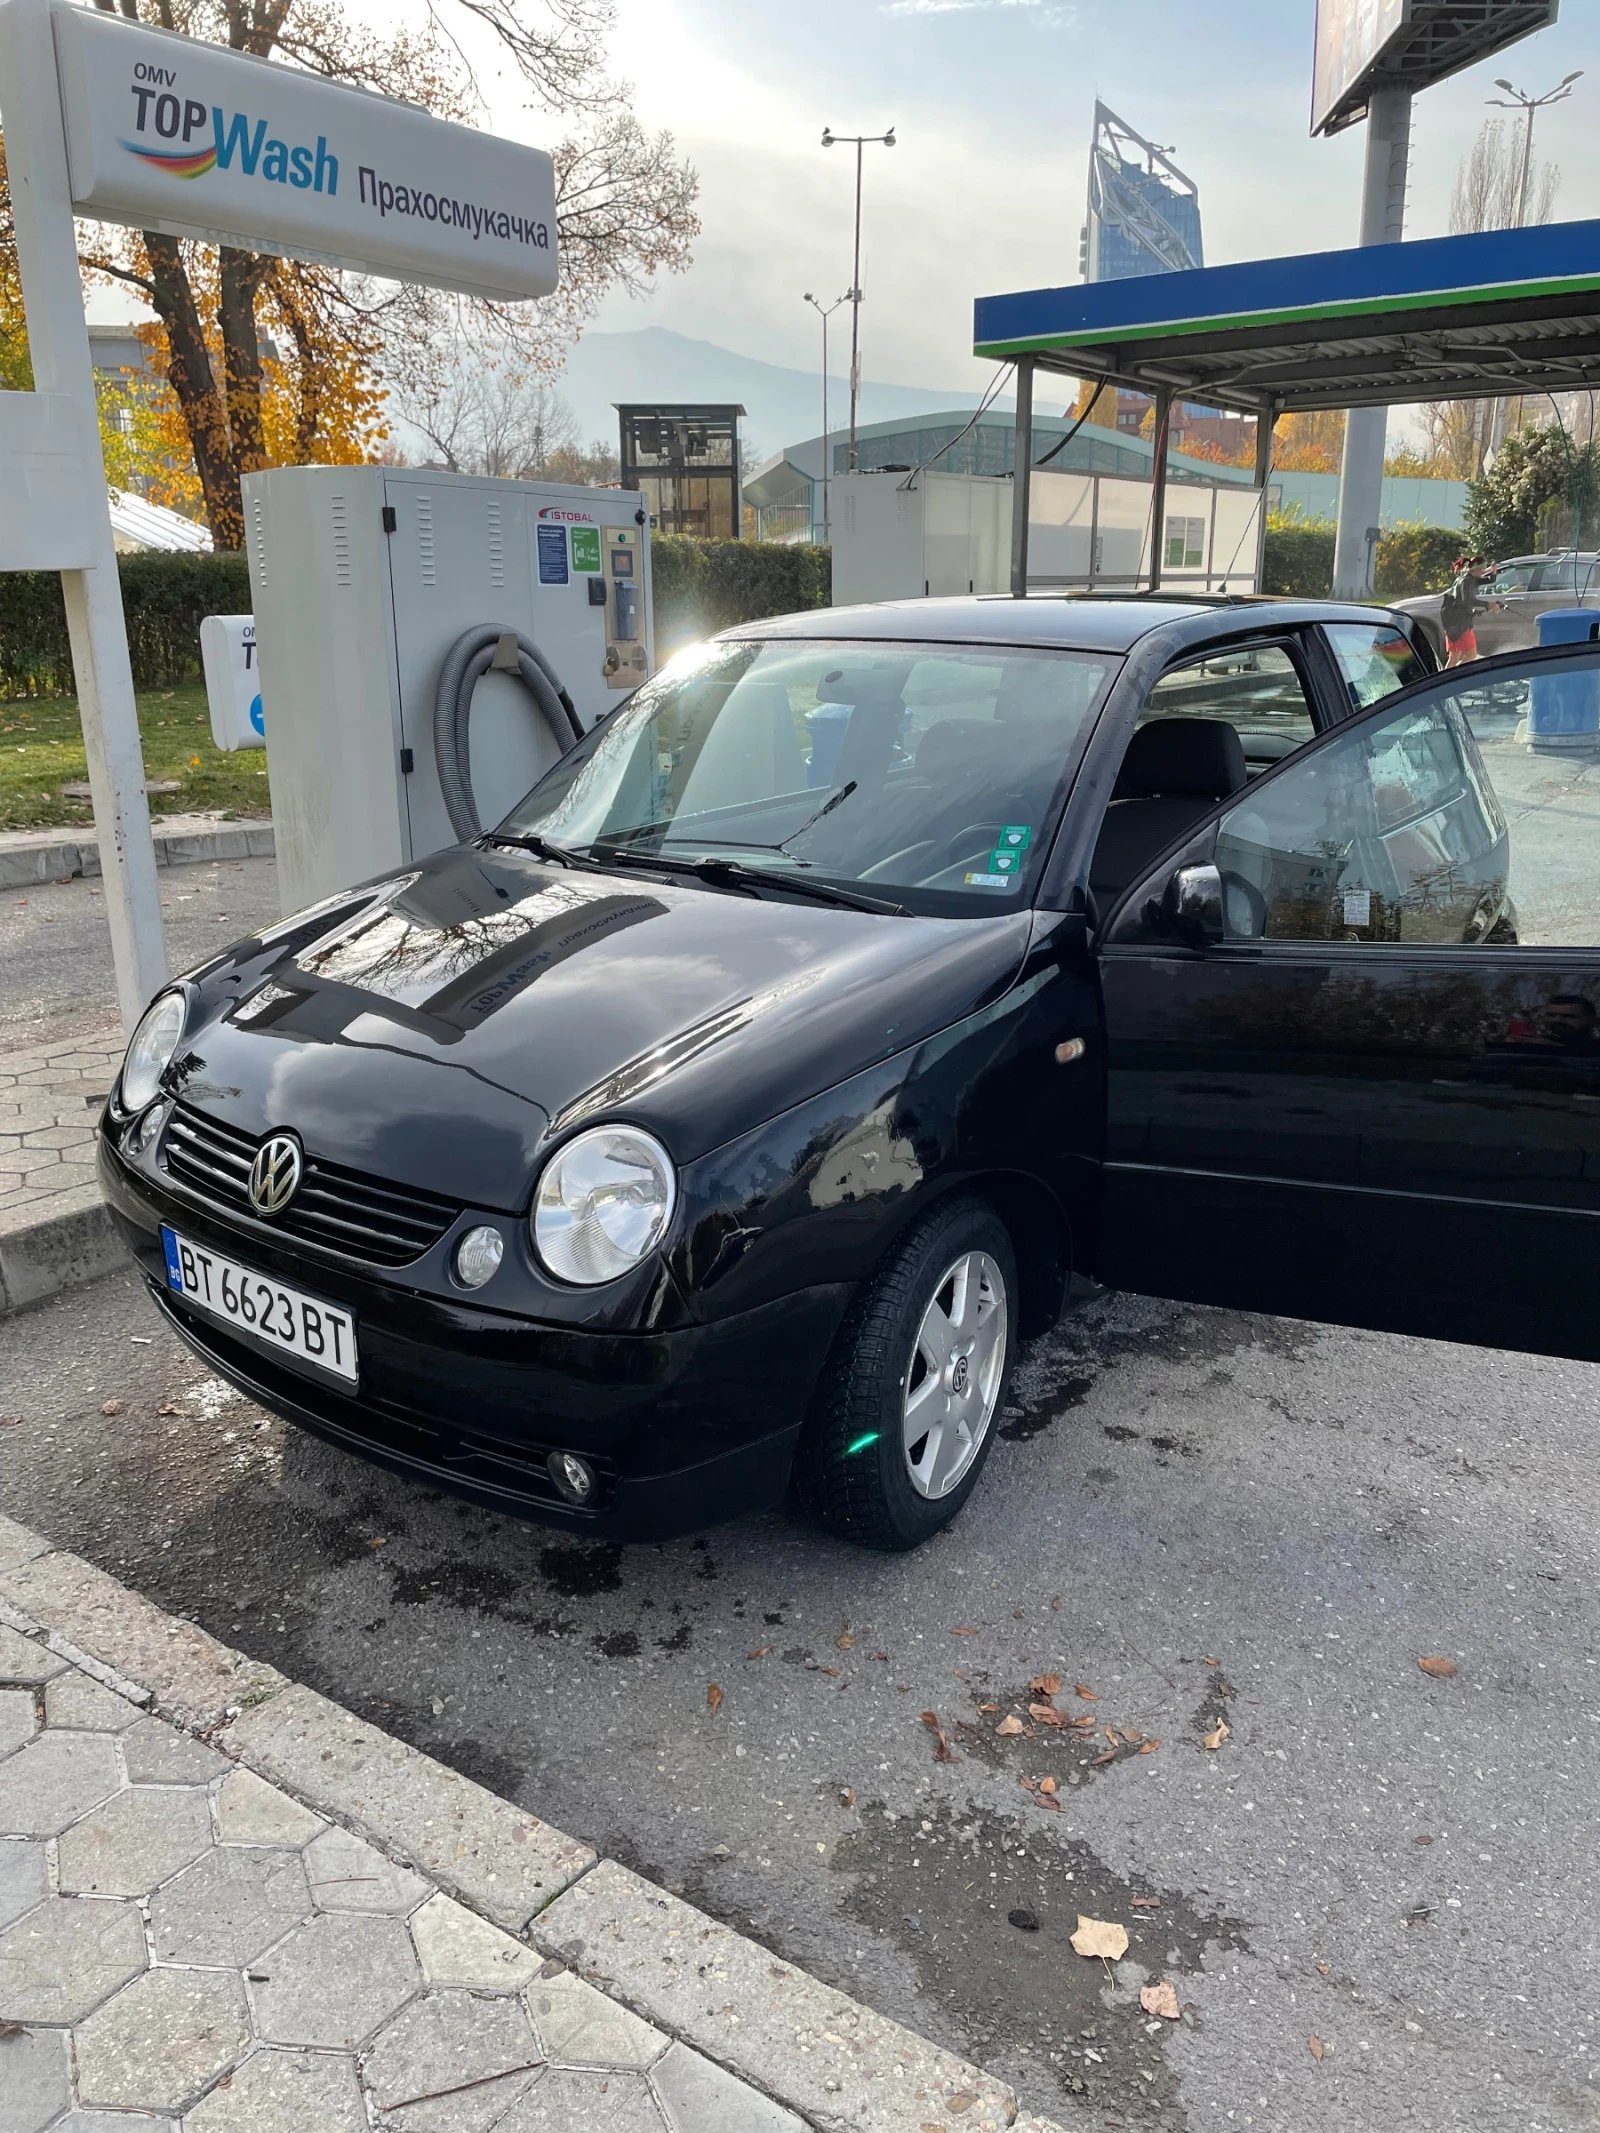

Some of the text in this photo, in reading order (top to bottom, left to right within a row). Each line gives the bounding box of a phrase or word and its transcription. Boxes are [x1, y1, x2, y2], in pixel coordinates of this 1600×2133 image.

[134, 62, 177, 87] OMV
[358, 166, 549, 249] Прахосмукачка
[551, 511, 593, 522] ISTOBAL
[170, 1265, 181, 1283] BG
